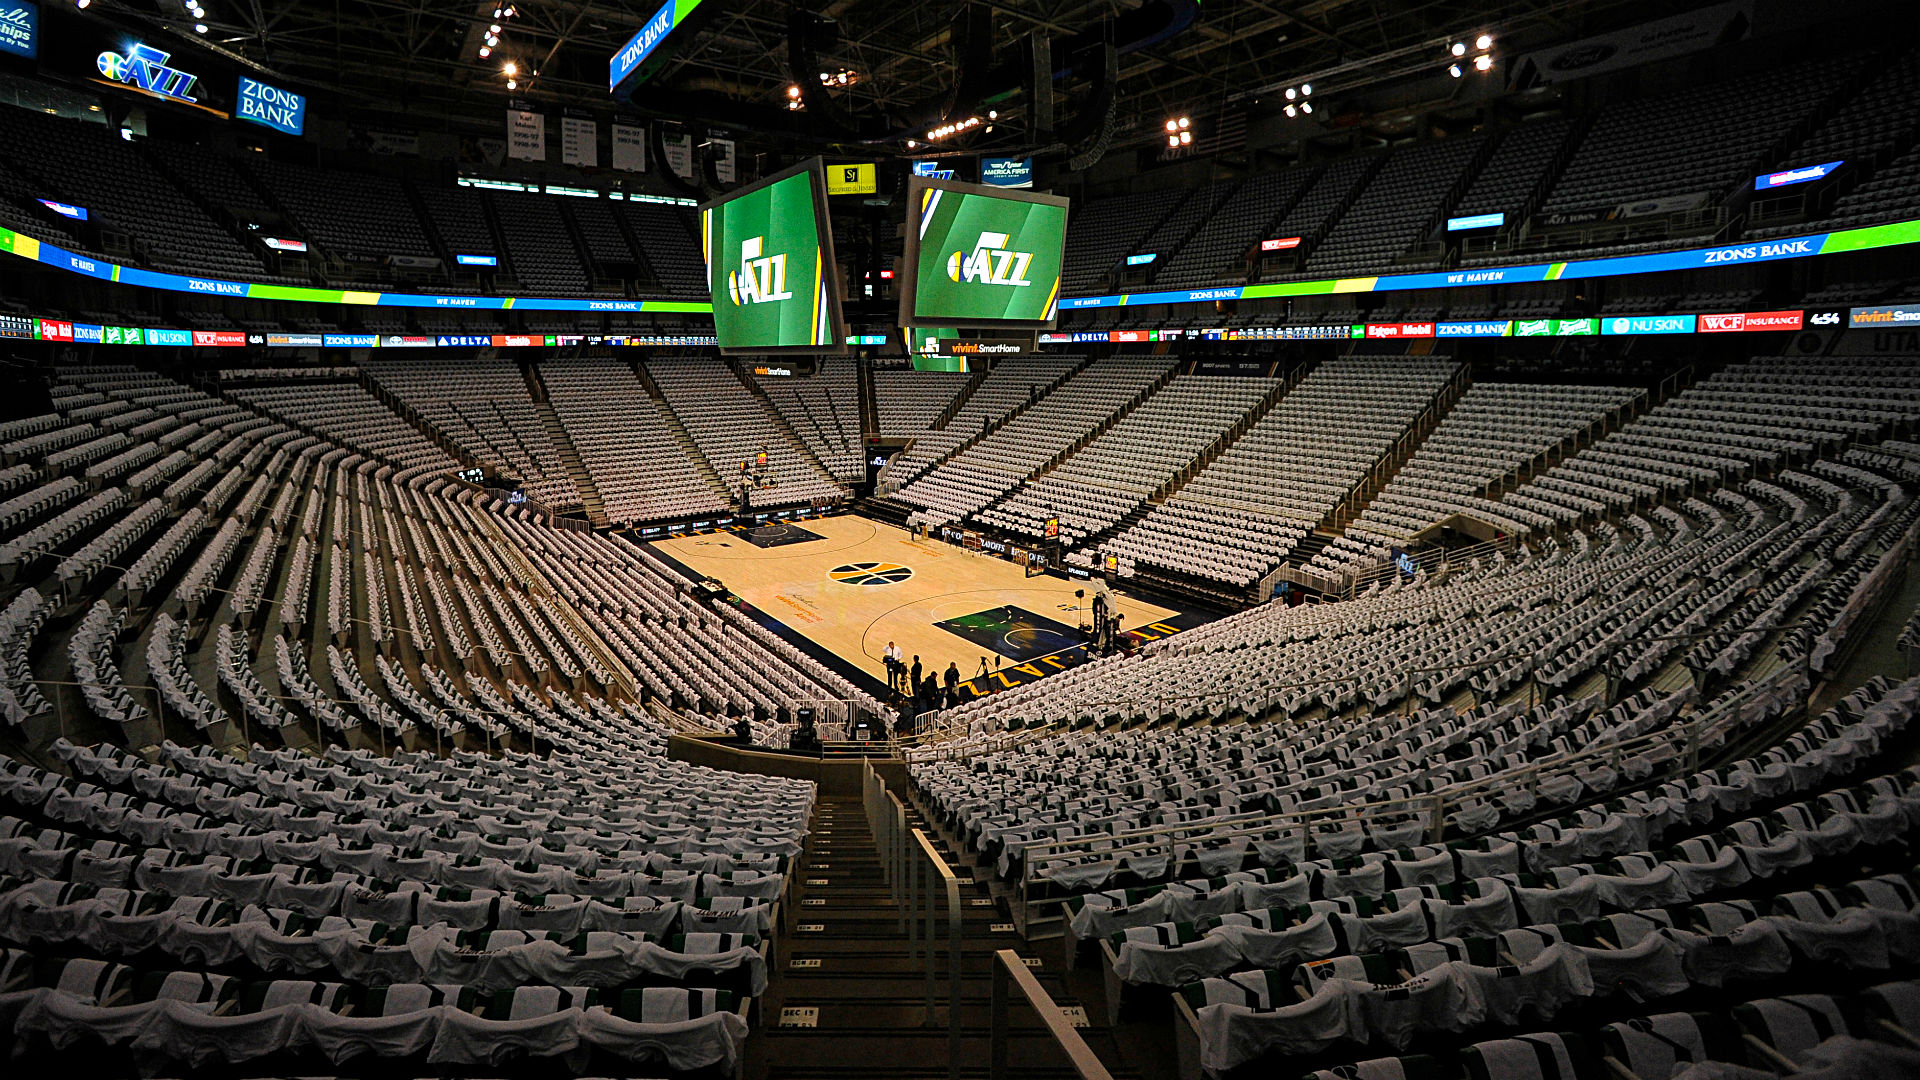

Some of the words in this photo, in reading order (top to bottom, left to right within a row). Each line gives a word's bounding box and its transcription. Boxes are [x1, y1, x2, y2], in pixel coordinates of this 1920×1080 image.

[621, 36, 644, 72] ZIONS
[644, 10, 670, 49] BANK
[121, 43, 197, 103] JAZZ
[243, 78, 299, 110] ZIONS
[242, 97, 298, 129] BANK
[984, 168, 1011, 176] AMERICA
[1704, 247, 1756, 263] ZIONS
[1760, 240, 1812, 257] BANK
[963, 231, 1034, 286] JAZZ
[740, 236, 792, 304] JAZZ
[1447, 274, 1464, 283] WE
[1466, 271, 1504, 282] HAVEN
[188, 280, 215, 292] ZIONS
[216, 282, 243, 294] BANK
[1189, 291, 1213, 300] ZIONS
[1214, 290, 1237, 298] BANK
[450, 298, 476, 306] HAVEN
[615, 302, 637, 310] BANK
[1632, 320, 1653, 331] NU
[1654, 319, 1684, 331] SKIN
[1704, 316, 1742, 329] WCF
[1746, 316, 1799, 326] INSURANCE
[74, 327, 89, 339] ZIONS
[1368, 325, 1397, 338] Exxon
[1402, 324, 1431, 335] Mobil
[1438, 324, 1472, 335] ZIONS
[1474, 323, 1506, 334] BANK
[159, 332, 169, 342] NU
[169, 333, 186, 343] SKIN
[195, 333, 216, 344] WCF
[326, 336, 352, 344] ZIONS
[353, 337, 375, 345] BANK
[450, 336, 490, 345] DELTA
[1081, 333, 1109, 341] DELTA
[1874, 331, 1919, 351] UTA
